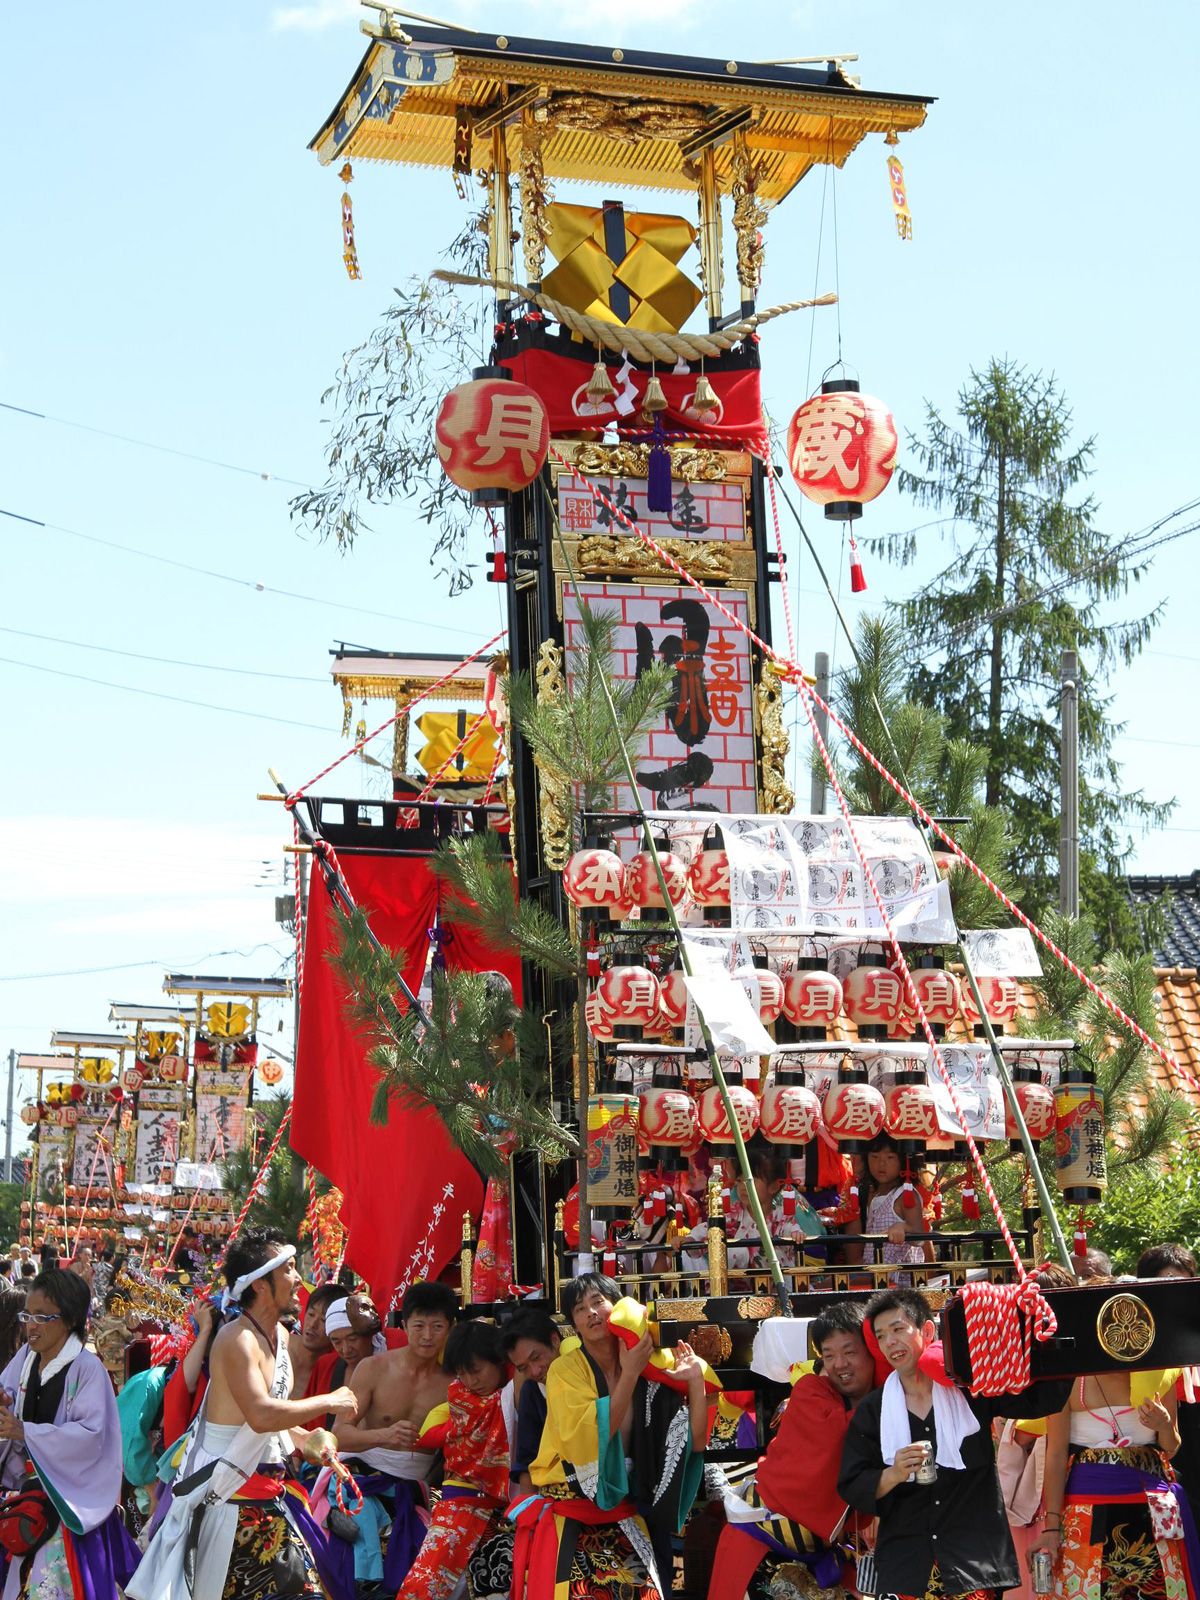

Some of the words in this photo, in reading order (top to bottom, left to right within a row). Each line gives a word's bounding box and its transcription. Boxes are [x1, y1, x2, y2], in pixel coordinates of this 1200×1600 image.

[473, 394, 544, 476] 貝
[792, 397, 865, 489] 蔵
[622, 980, 656, 1017] 貝
[800, 985, 836, 1020] 貝
[865, 979, 899, 1017] 貝
[922, 981, 954, 1016] 貝
[772, 1093, 817, 1138] 蔵
[834, 1090, 879, 1135] 蔵
[891, 1092, 936, 1135] 蔵
